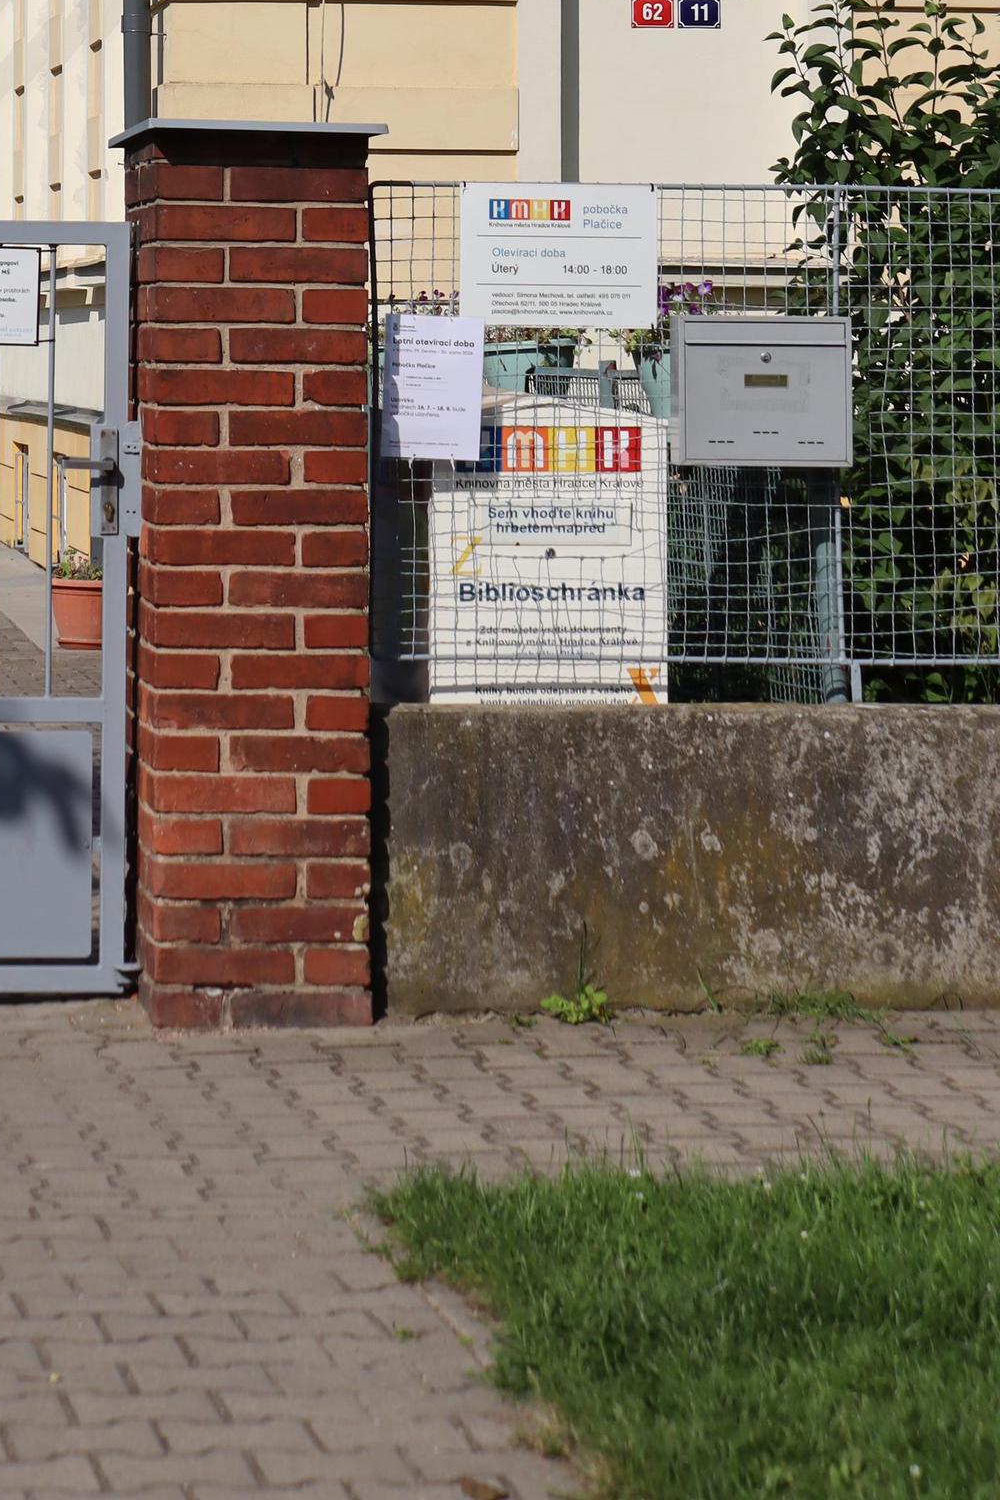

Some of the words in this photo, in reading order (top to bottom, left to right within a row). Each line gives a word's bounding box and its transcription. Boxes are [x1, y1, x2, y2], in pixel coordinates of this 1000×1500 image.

[642, 3, 663, 21] 62
[690, 4, 708, 22] 11
[583, 204, 628, 216] pobočka
[583, 218, 622, 229] Plačice
[540, 248, 566, 258] doba
[491, 261, 519, 275] Úterý
[563, 265, 590, 275] 14:00
[601, 265, 628, 275] 18:00
[453, 340, 475, 348] doba
[514, 477, 550, 489] města
[554, 477, 596, 489] Hradce
[488, 507, 518, 519] Sem
[523, 507, 571, 519] vhoďte
[576, 507, 614, 519] knihu
[496, 522, 553, 533] hřbetem
[557, 522, 605, 536] napřed
[459, 582, 646, 602] Biblioschránka
